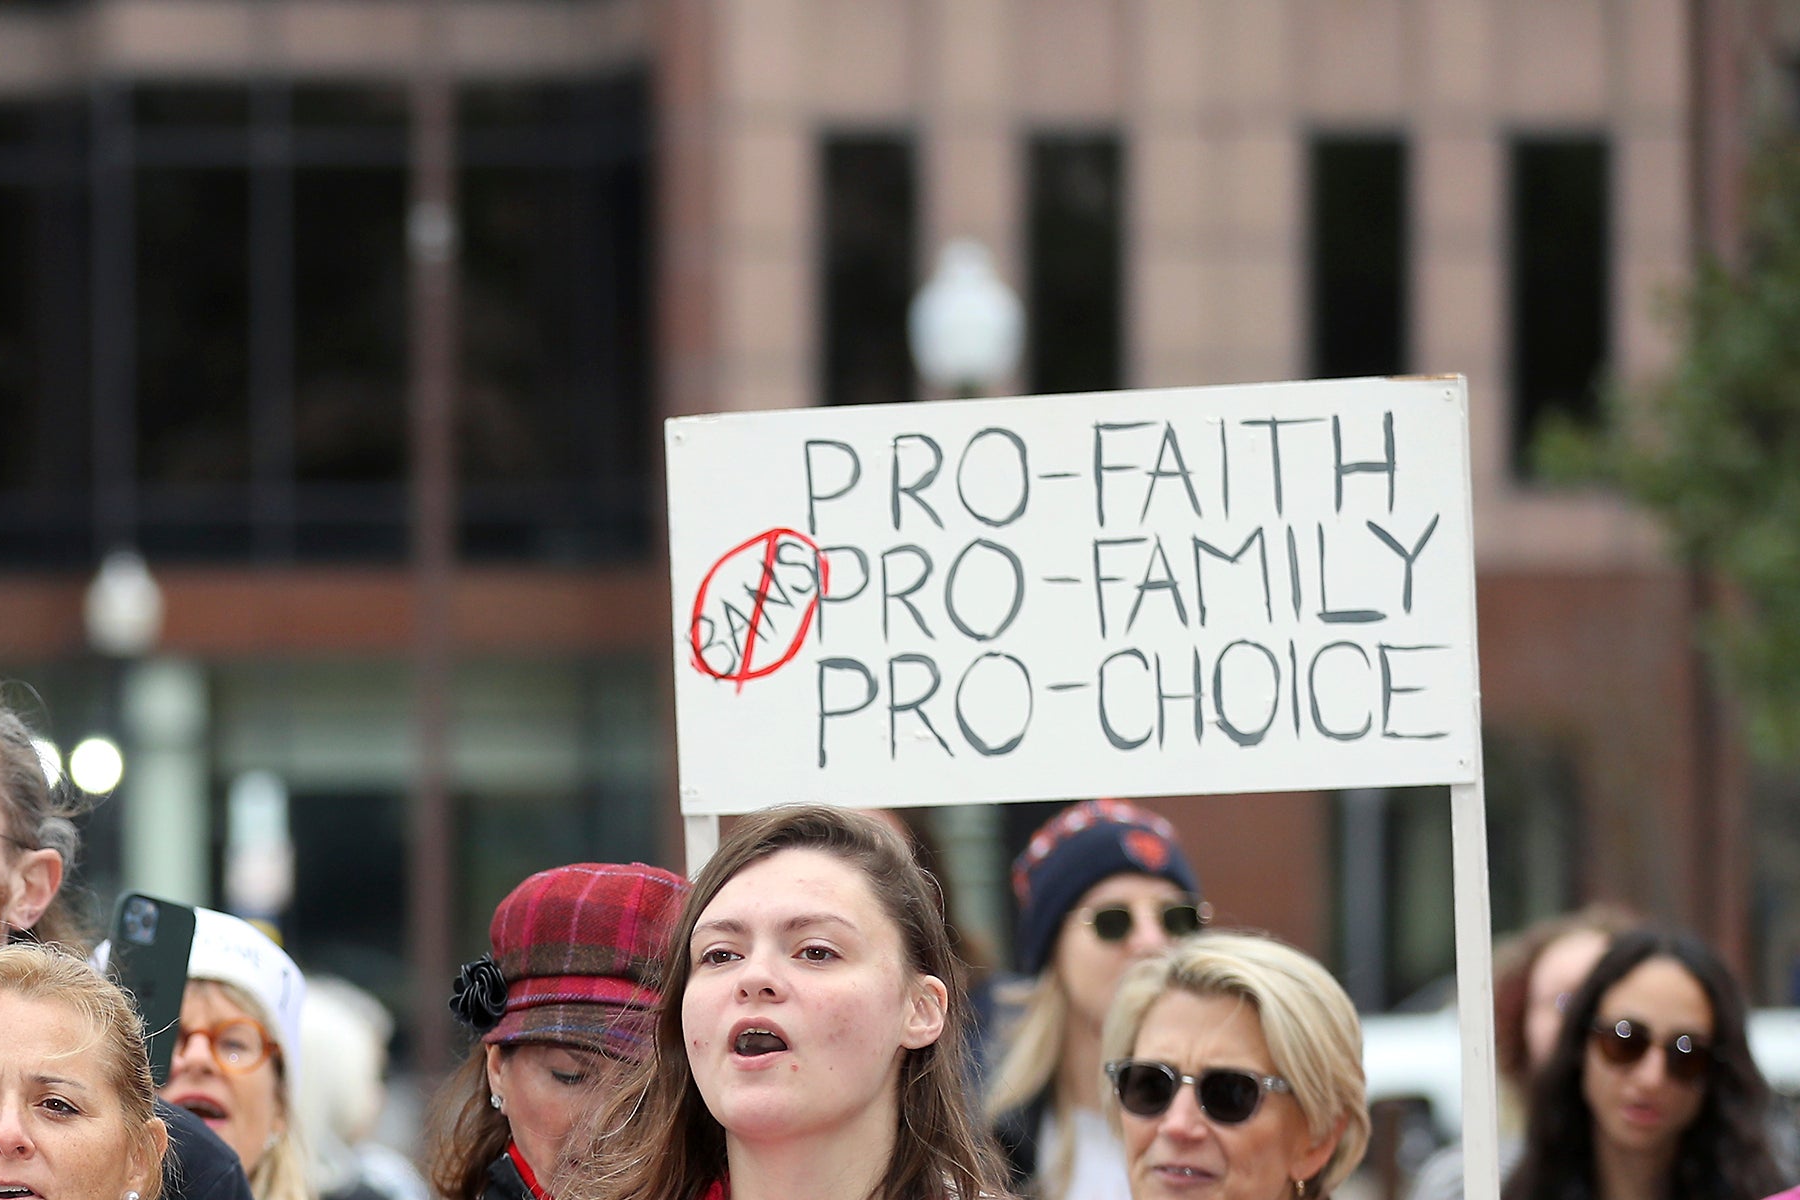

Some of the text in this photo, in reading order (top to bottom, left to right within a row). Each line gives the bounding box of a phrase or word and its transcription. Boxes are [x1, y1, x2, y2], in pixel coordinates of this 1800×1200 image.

[804, 411, 1397, 536] PRO-FAITH
[686, 541, 816, 682] BANS
[814, 513, 1441, 642] PRO-FAMILY
[817, 641, 1452, 770] PRO-CHOICE
